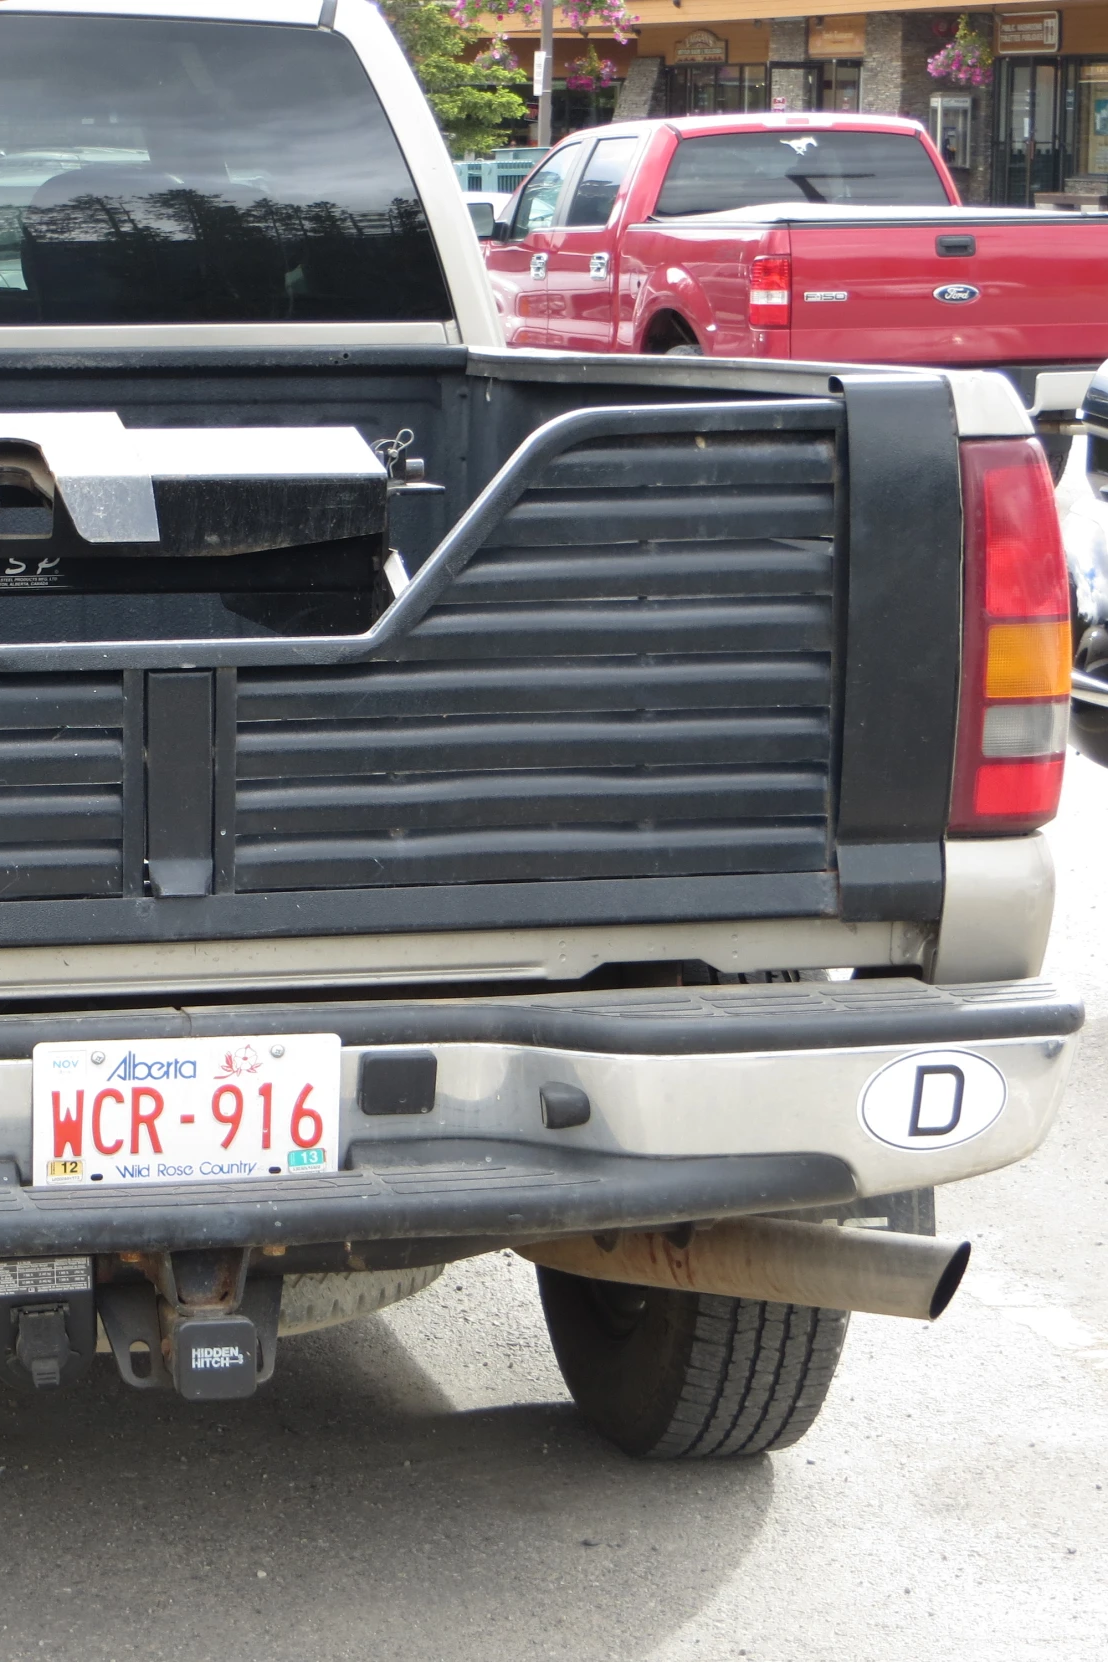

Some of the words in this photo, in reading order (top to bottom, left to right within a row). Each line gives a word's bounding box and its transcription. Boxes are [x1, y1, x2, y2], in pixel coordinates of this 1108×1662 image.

[944, 287, 970, 300] Ford
[52, 1059, 79, 1069] NOV
[106, 1050, 197, 1081] Alberta
[907, 1063, 965, 1137] D
[51, 1082, 323, 1158] WCR-916
[300, 1150, 319, 1164] 13
[61, 1161, 78, 1174] 12
[115, 1163, 150, 1179] Wild
[157, 1161, 194, 1178] Rose
[199, 1160, 258, 1177] Country
[191, 1346, 239, 1358] HIDDEN
[191, 1356, 230, 1369] HITCH
